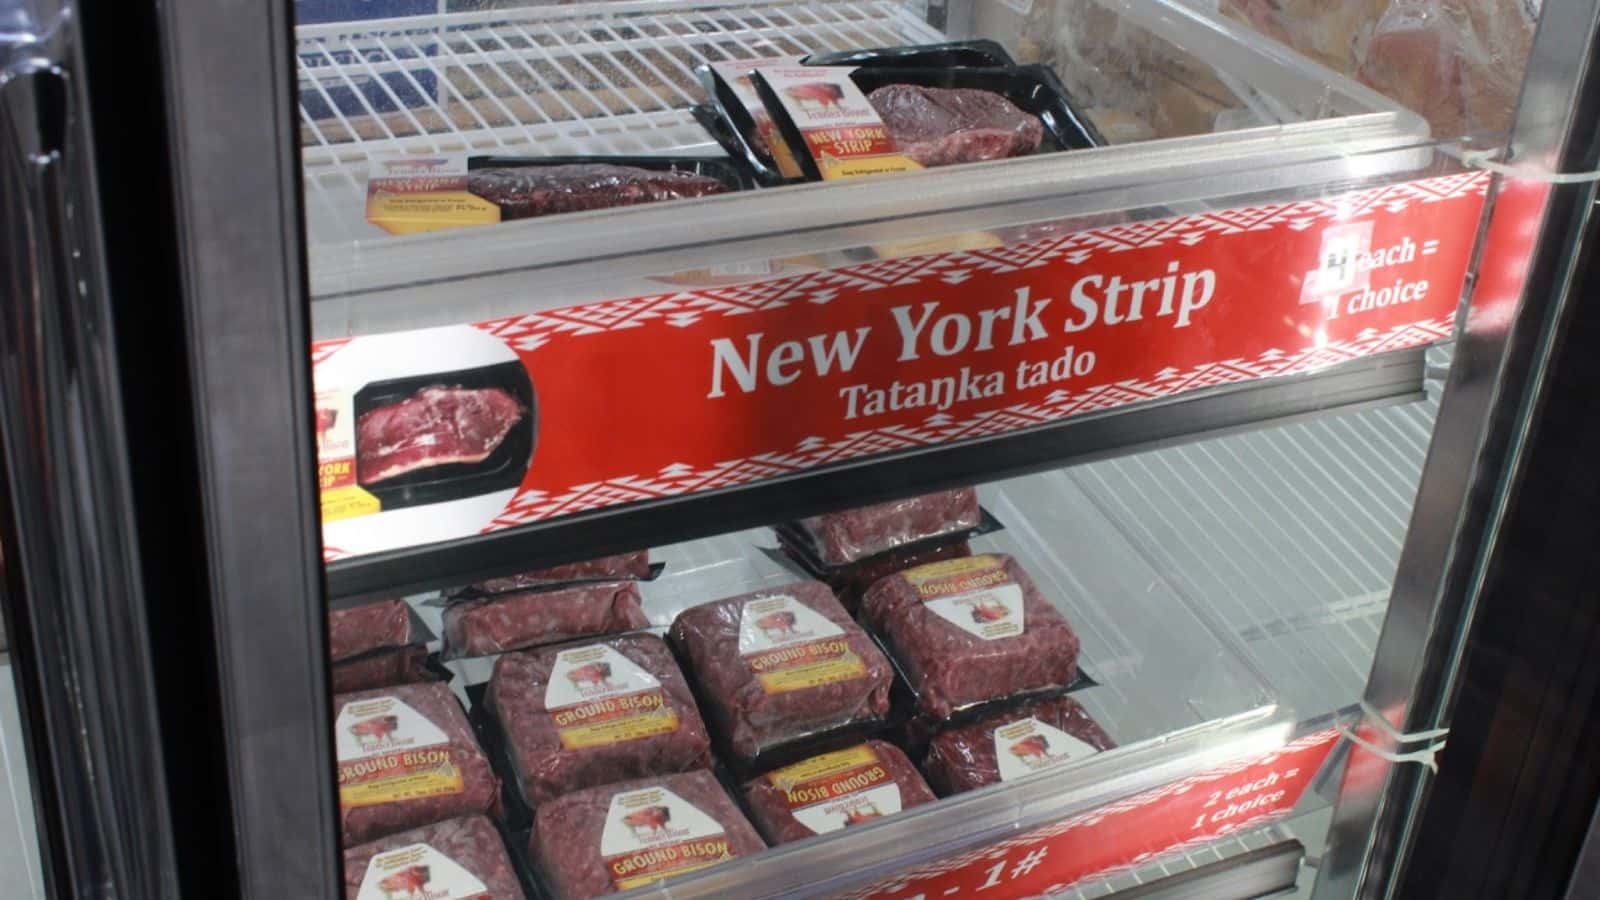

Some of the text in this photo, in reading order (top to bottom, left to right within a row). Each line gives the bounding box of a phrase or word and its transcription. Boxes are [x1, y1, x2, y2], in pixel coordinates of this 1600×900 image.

[808, 127, 887, 145] NEW YORK
[832, 140, 873, 155] STRIP
[1355, 236, 1417, 272] each
[1326, 278, 1430, 320] 1 choice
[707, 261, 1218, 399] New York Strip
[1015, 346, 1096, 393] tado
[751, 647, 806, 670] GROUND
[808, 641, 849, 656] BISON
[555, 701, 615, 726] GROUND
[618, 695, 665, 710] BISON
[403, 751, 451, 766] BISON
[787, 786, 830, 804] BISON
[831, 766, 886, 794] GROUND
[1203, 790, 1223, 808] 2
[1225, 771, 1280, 800] each
[1191, 790, 1286, 830] 1 choice
[613, 841, 730, 875] GROUND BISON
